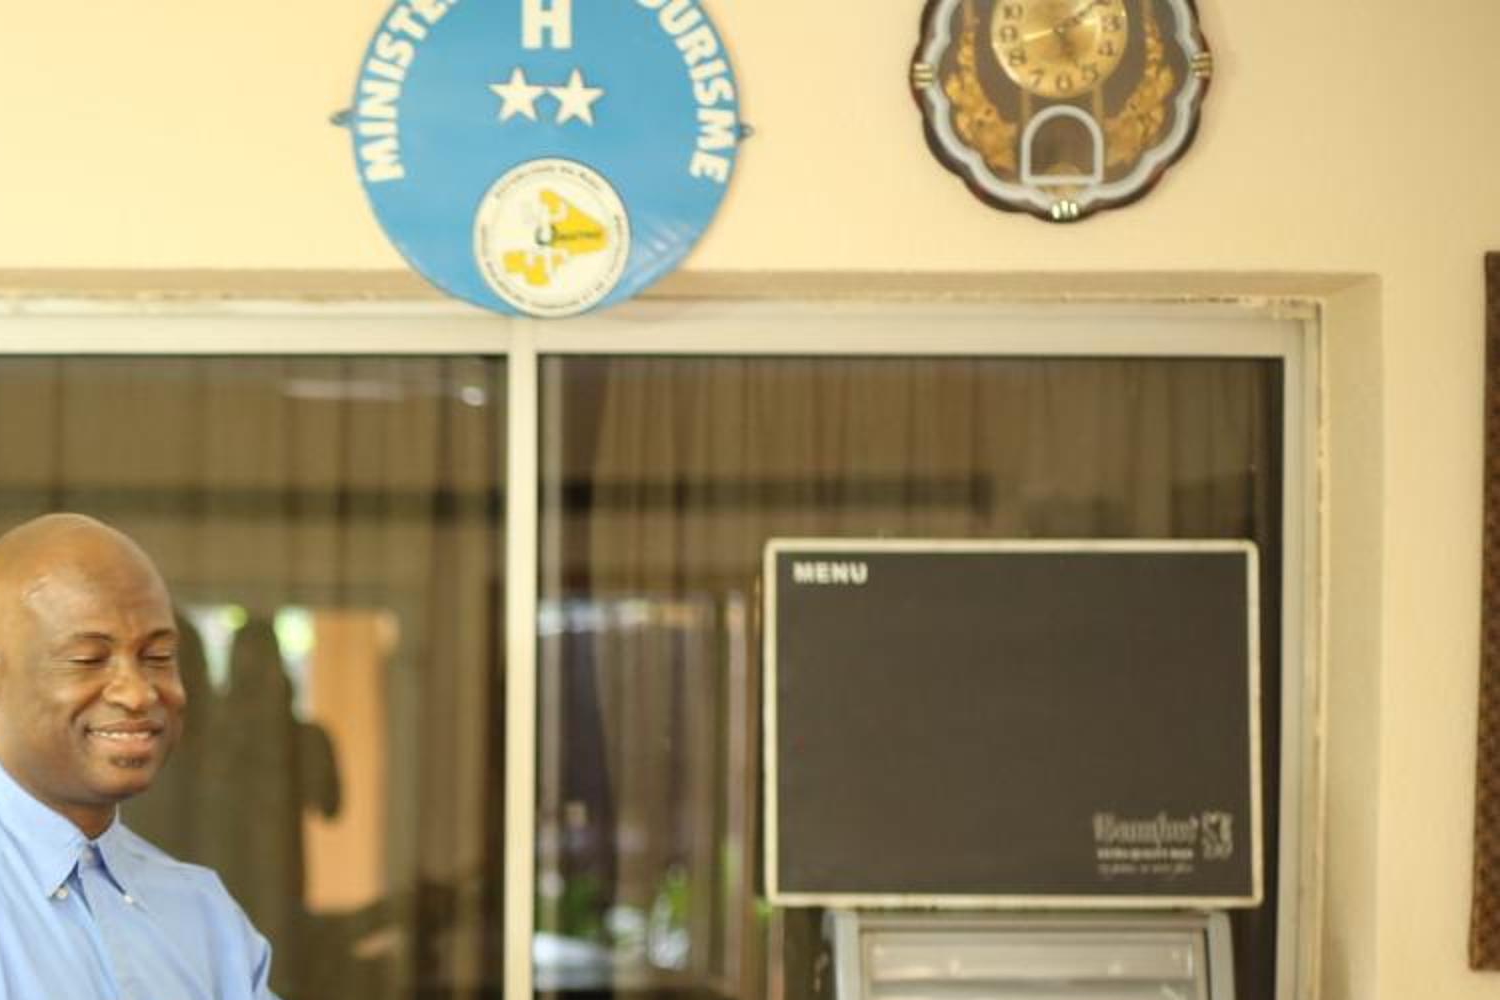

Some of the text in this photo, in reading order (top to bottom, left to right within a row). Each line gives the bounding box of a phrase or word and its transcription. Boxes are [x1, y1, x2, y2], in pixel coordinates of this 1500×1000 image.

[521, 0, 571, 49] H
[358, 0, 736, 184] MINISTE URISME
[793, 561, 868, 585] MENU
